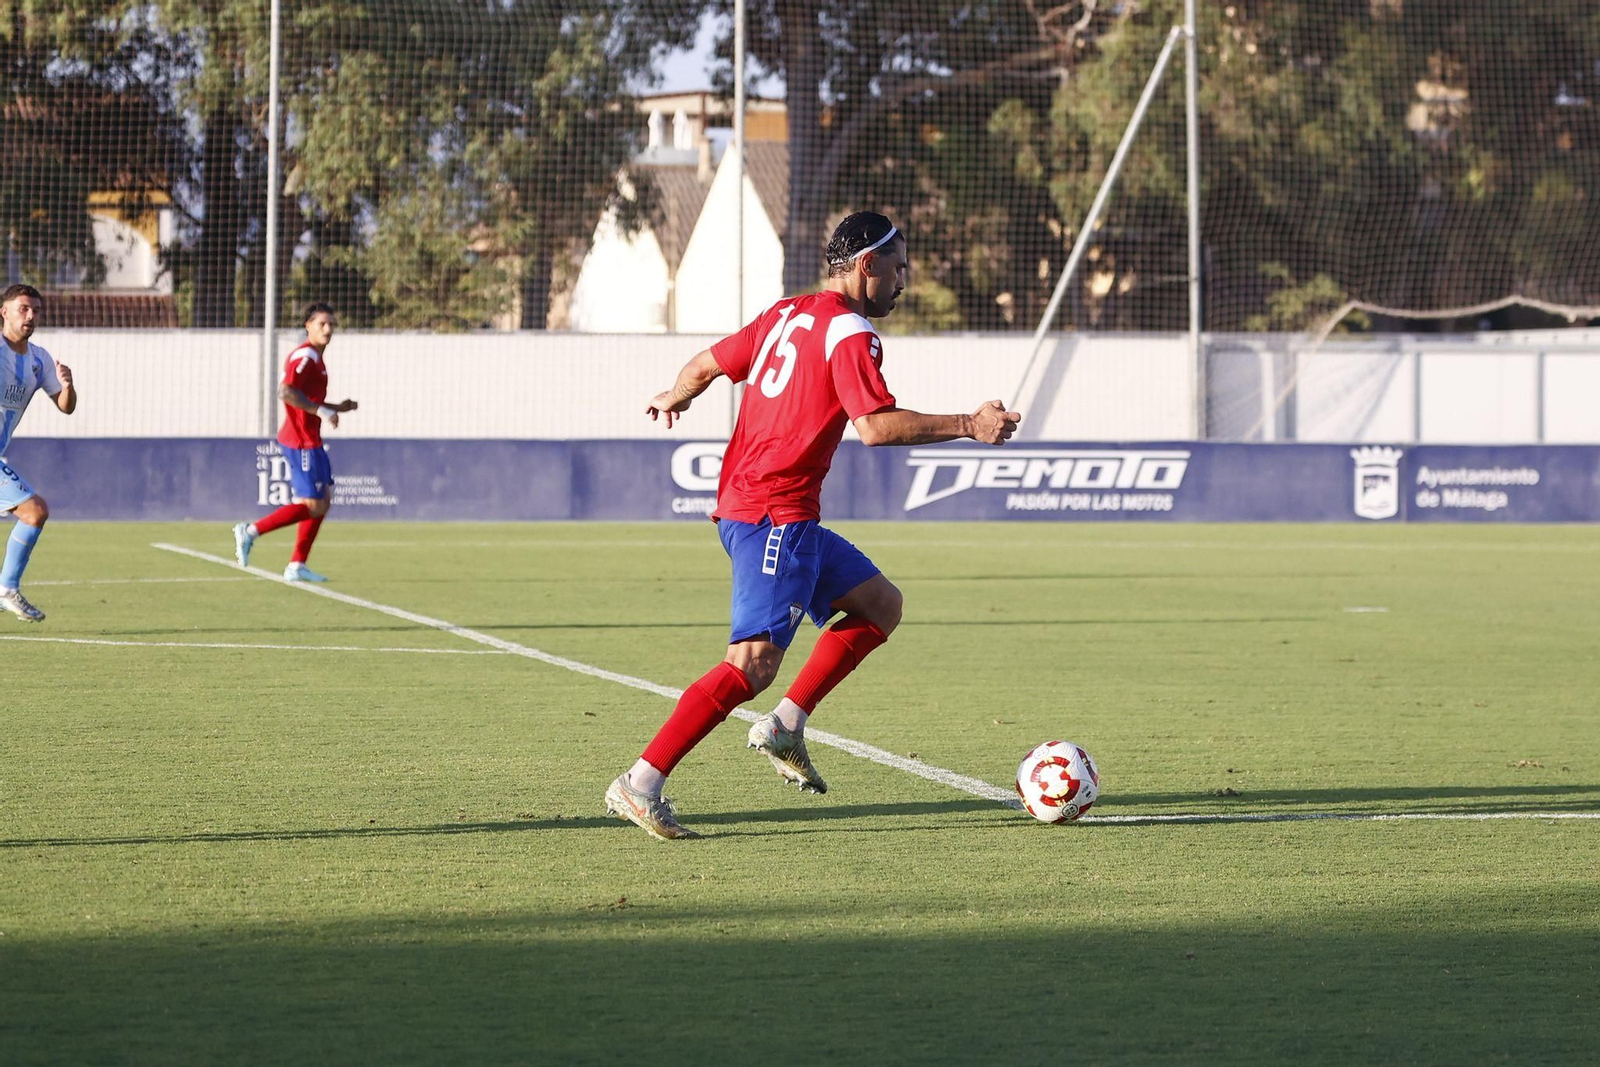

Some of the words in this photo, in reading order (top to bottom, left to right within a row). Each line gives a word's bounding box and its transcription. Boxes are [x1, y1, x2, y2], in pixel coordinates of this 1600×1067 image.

[746, 304, 815, 398] 15
[334, 476, 379, 486] PRODUCTOS
[1416, 465, 1540, 488] Ayuntamiento
[334, 495, 344, 505] DE
[345, 495, 356, 505] LA
[357, 495, 399, 505] PROVINCIA
[1006, 491, 1059, 511] PASIÓN
[1060, 494, 1091, 511] POR
[1092, 494, 1121, 511] LAS
[1122, 494, 1174, 511] MOTOS
[1416, 489, 1440, 508] de
[1441, 487, 1508, 511] Málaga
